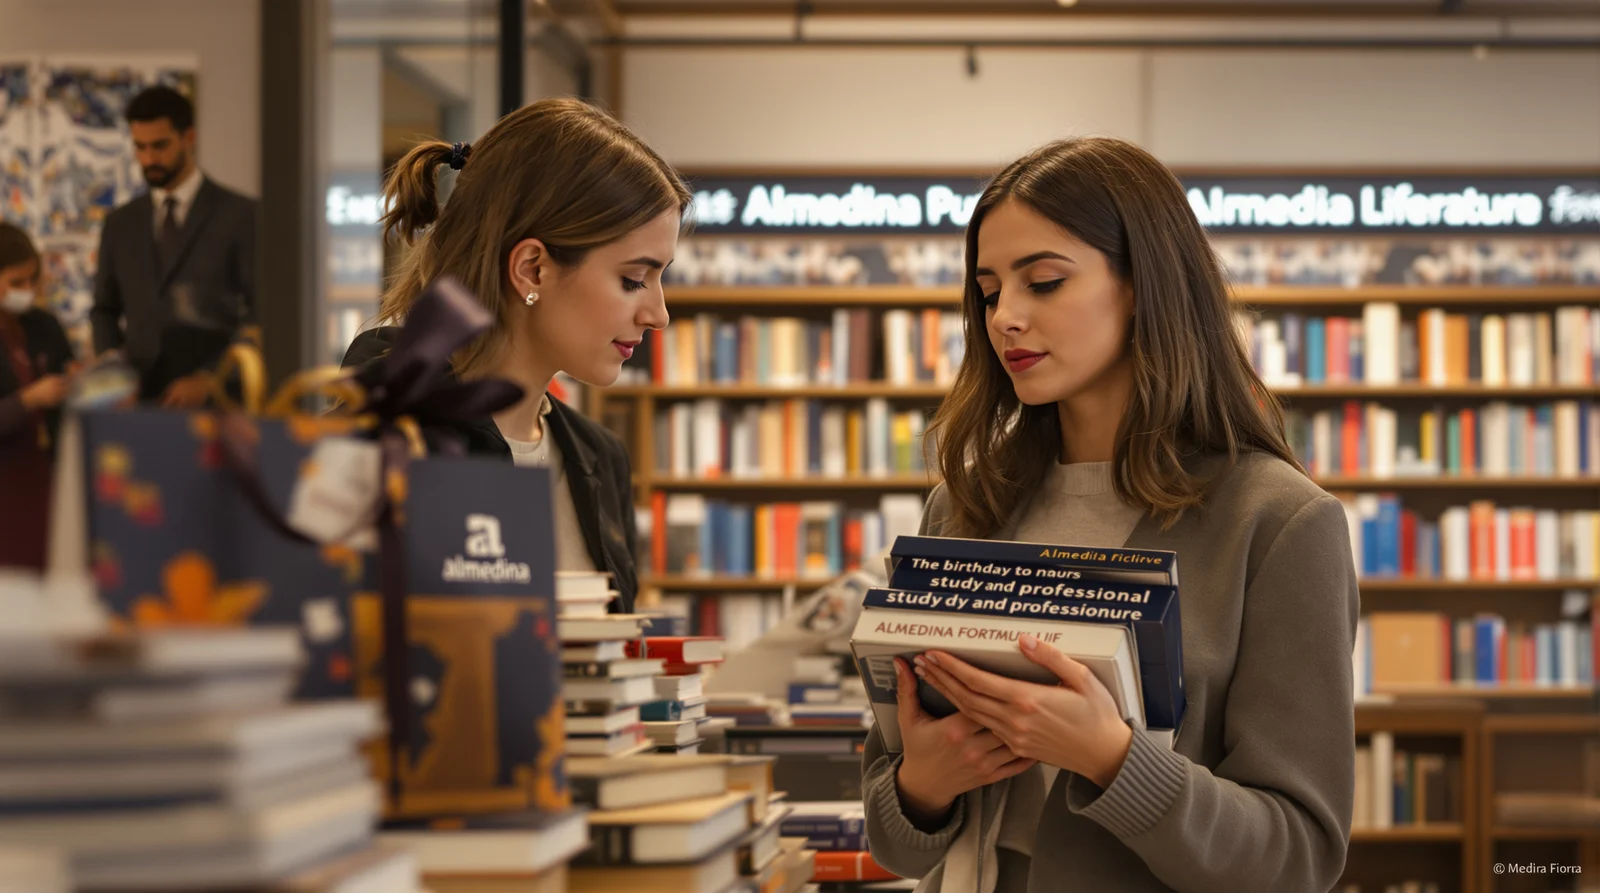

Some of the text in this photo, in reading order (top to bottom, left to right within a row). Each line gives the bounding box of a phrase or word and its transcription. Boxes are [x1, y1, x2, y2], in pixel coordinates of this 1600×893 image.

[741, 183, 922, 226] Almedina
[442, 555, 531, 583] almedina
[911, 558, 940, 571] The
[943, 561, 1011, 577] birthday
[1015, 566, 1032, 577] to
[929, 577, 1151, 604] study and professional
[886, 591, 1143, 622] study dy and professionure
[874, 622, 954, 638] ALMEDINA
